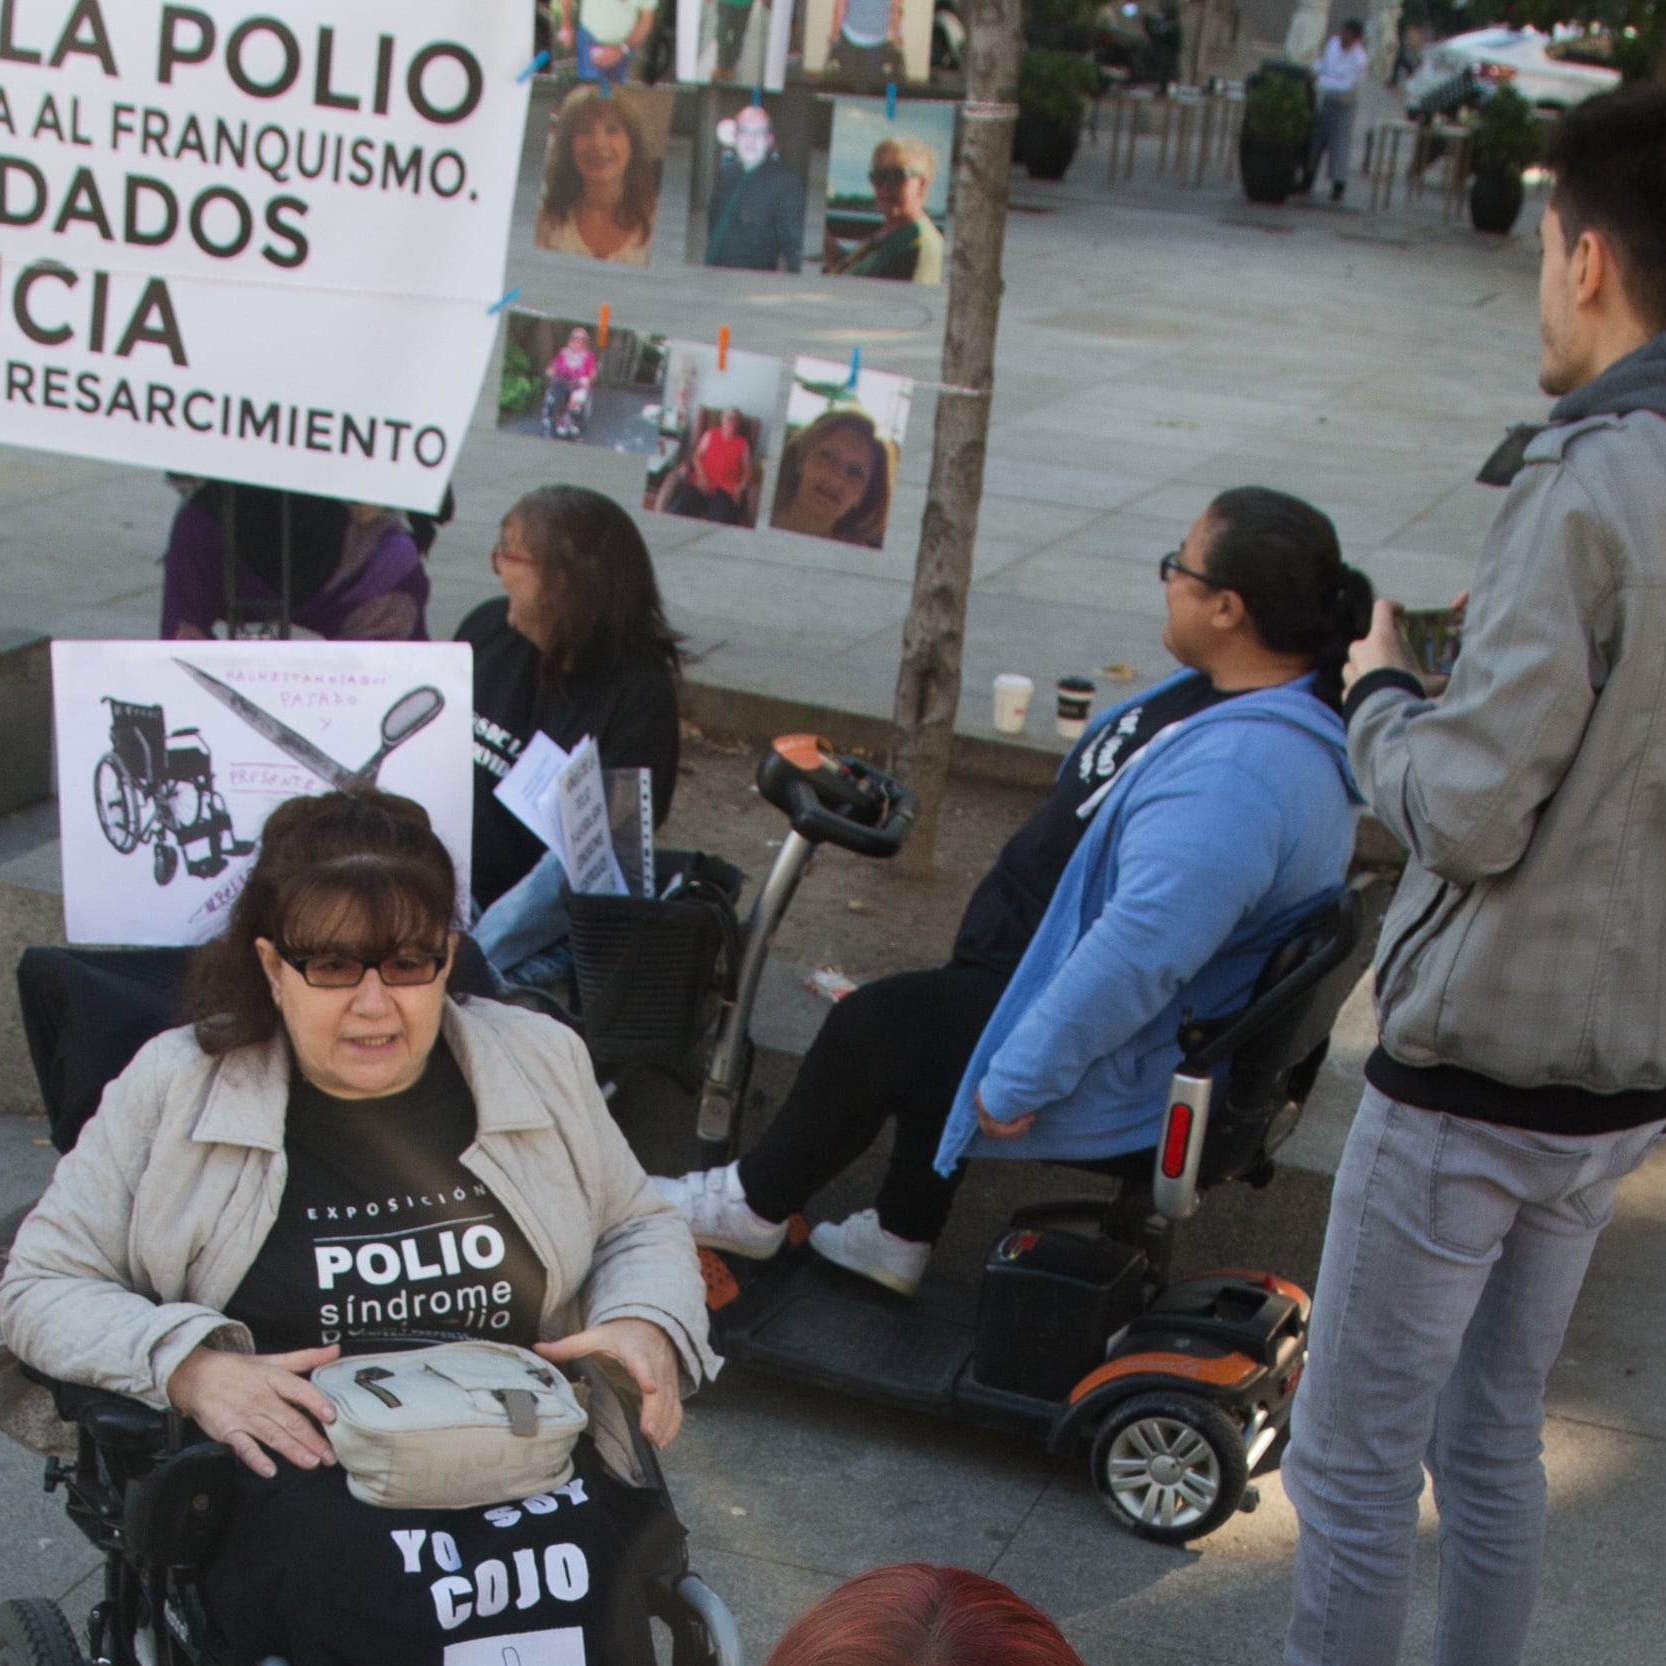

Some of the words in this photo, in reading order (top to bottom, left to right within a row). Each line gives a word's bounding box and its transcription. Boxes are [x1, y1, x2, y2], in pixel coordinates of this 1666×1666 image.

[158, 4, 484, 125] POLIO
[33, 93, 93, 145] AL
[111, 100, 478, 201] FRANQUISMO.
[6, 360, 447, 469] RESARCIMIENTO
[314, 1224, 506, 1290] POLIO
[320, 1280, 512, 1326] síndrome
[390, 1528, 463, 1574] YO
[483, 1478, 589, 1528] SOY
[430, 1541, 590, 1631] COJO
